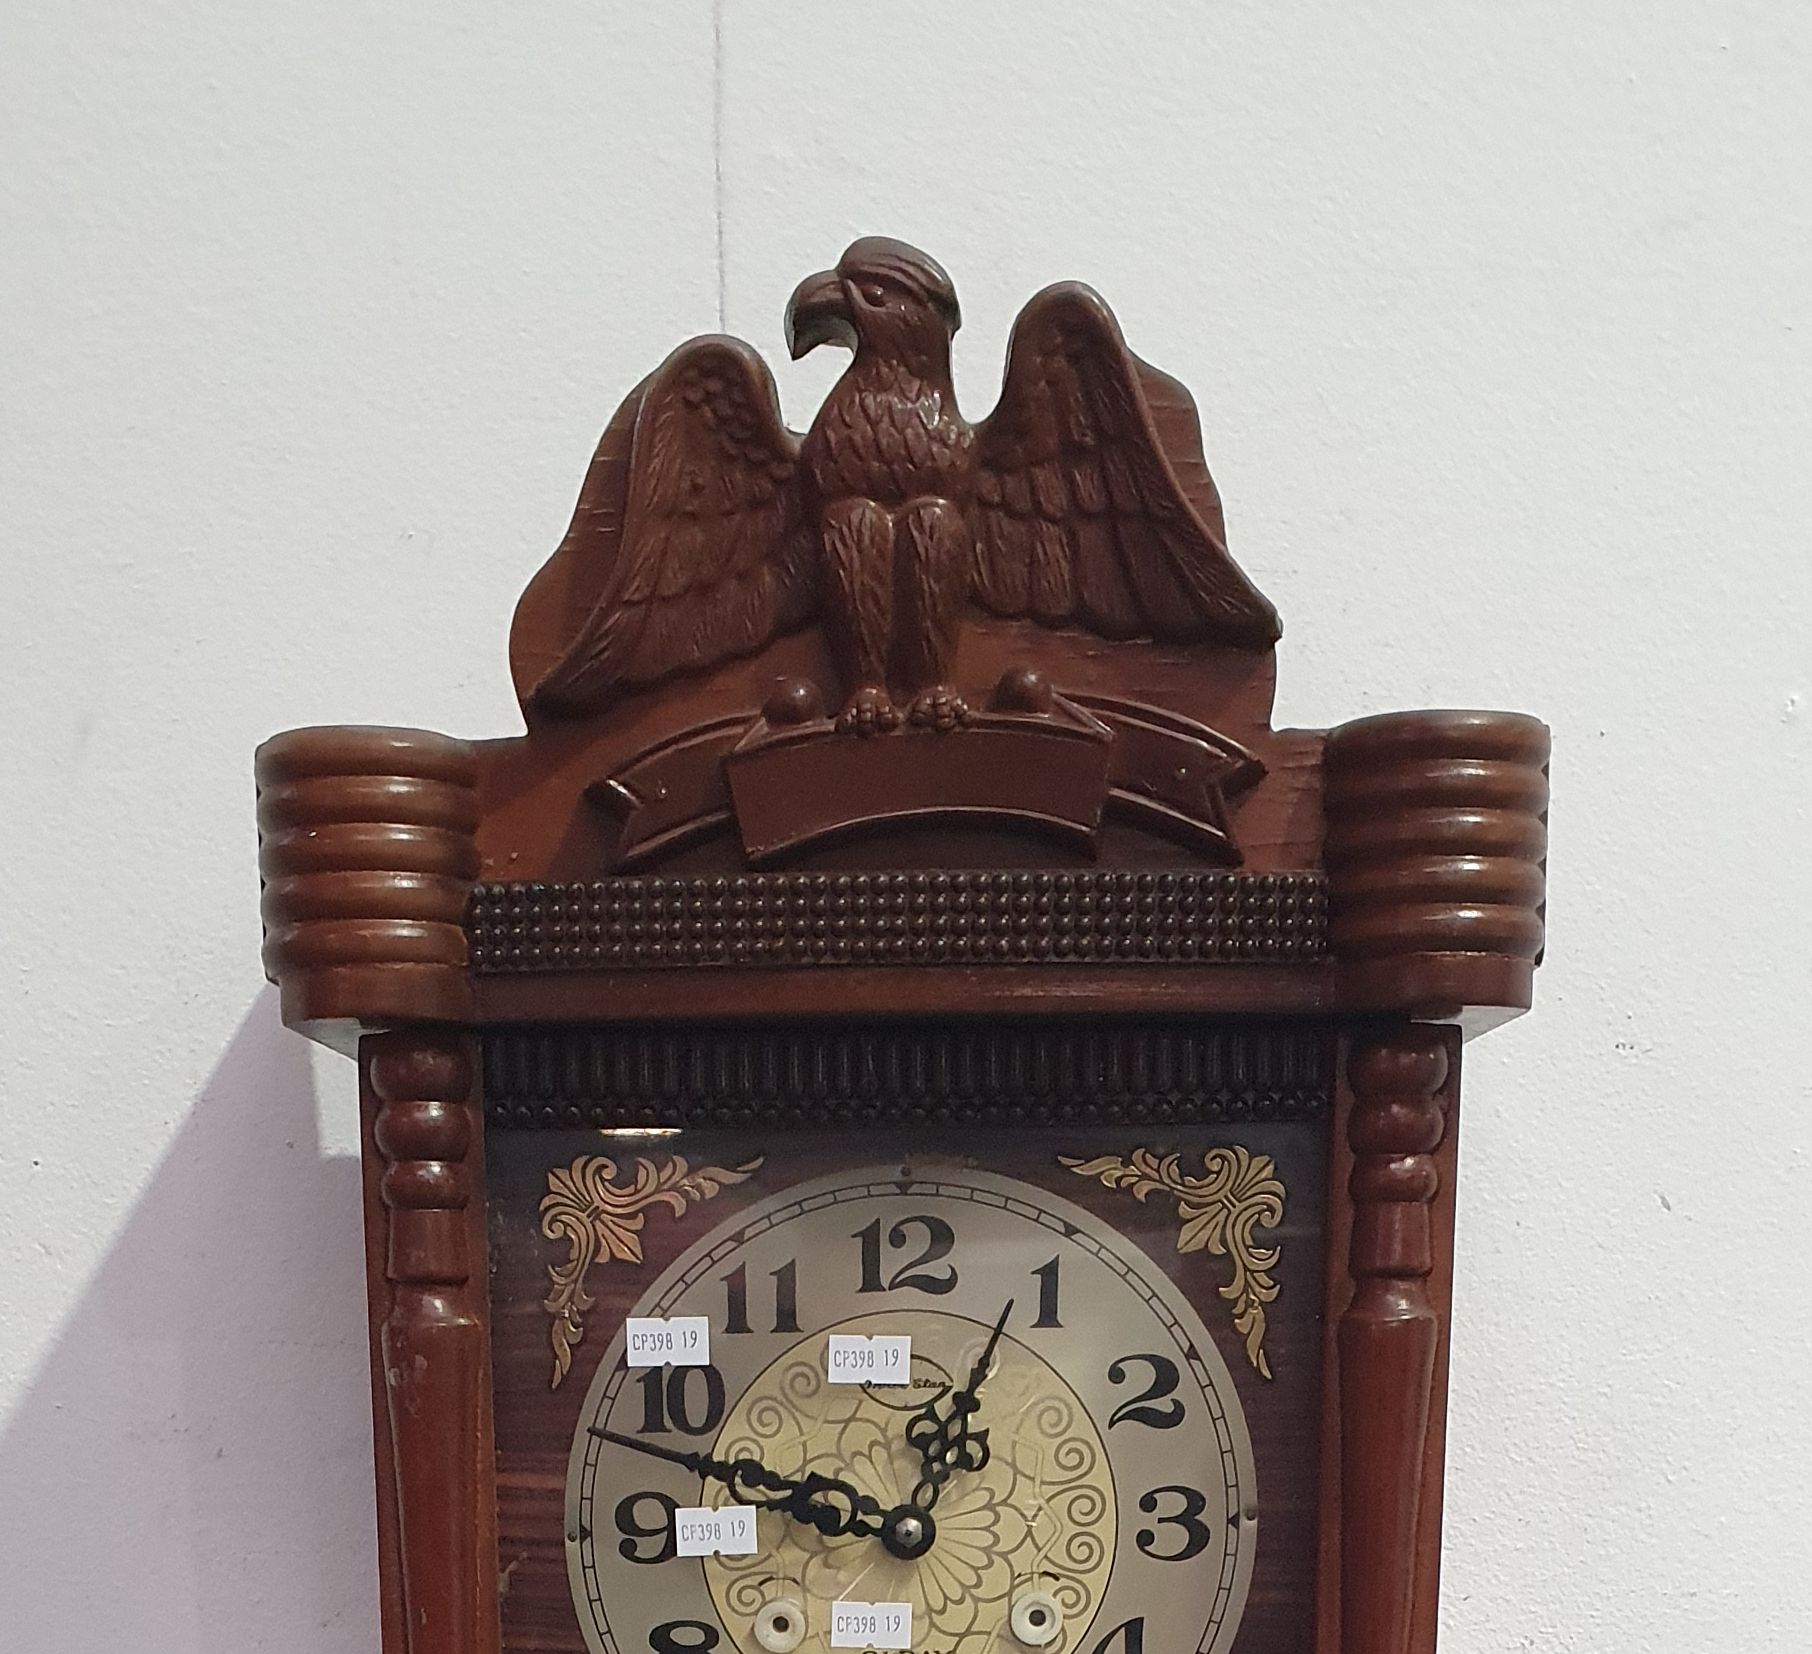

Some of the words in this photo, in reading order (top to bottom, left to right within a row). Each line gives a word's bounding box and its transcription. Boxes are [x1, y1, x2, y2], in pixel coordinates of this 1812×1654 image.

[851, 1215, 958, 1295] 12
[720, 1259, 804, 1335] 11
[1030, 1255, 1063, 1329] 1
[632, 1332, 673, 1352] CP398
[682, 1330, 698, 1349] 19
[833, 1350, 874, 1369] CP398
[884, 1348, 899, 1367] 19
[636, 1365, 726, 1436] 10
[1108, 1354, 1185, 1431] 2
[615, 1491, 680, 1564] 9
[731, 1520, 746, 1538] 19
[1136, 1486, 1210, 1562] 3
[837, 1616, 876, 1634] CP398
[886, 1615, 900, 1633] 19
